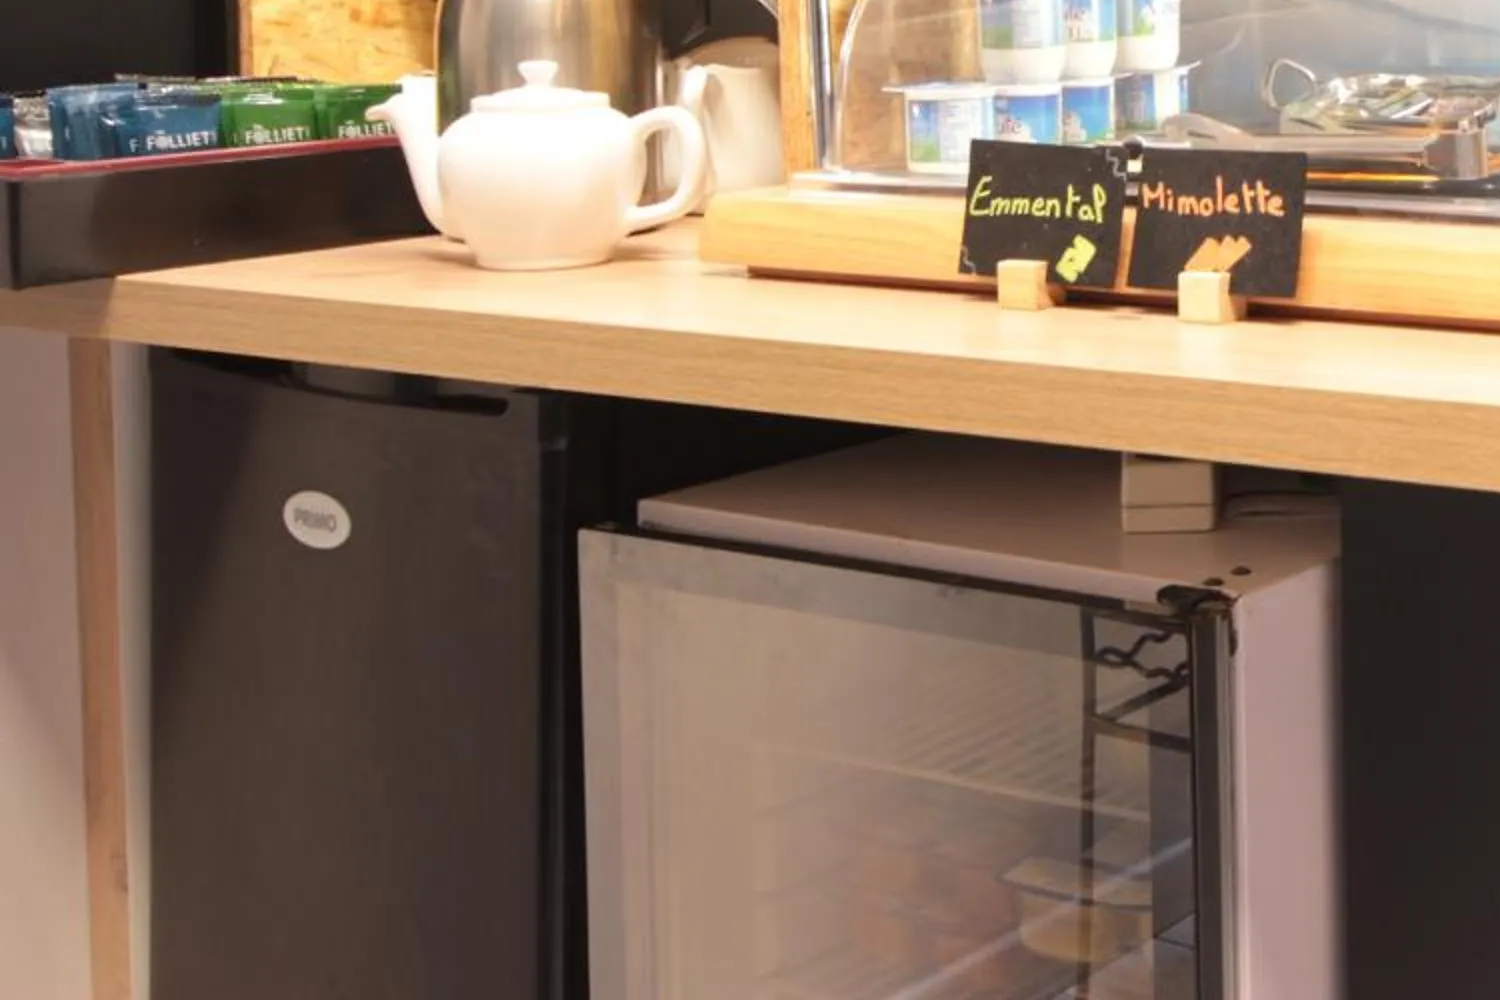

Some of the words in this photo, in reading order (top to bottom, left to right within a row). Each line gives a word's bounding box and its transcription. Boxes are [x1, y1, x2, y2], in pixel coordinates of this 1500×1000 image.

[147, 130, 211, 150] FOLLIET
[244, 125, 305, 145] FOLLIET
[969, 175, 1107, 224] Emmental
[1141, 175, 1286, 217] Mimolette
